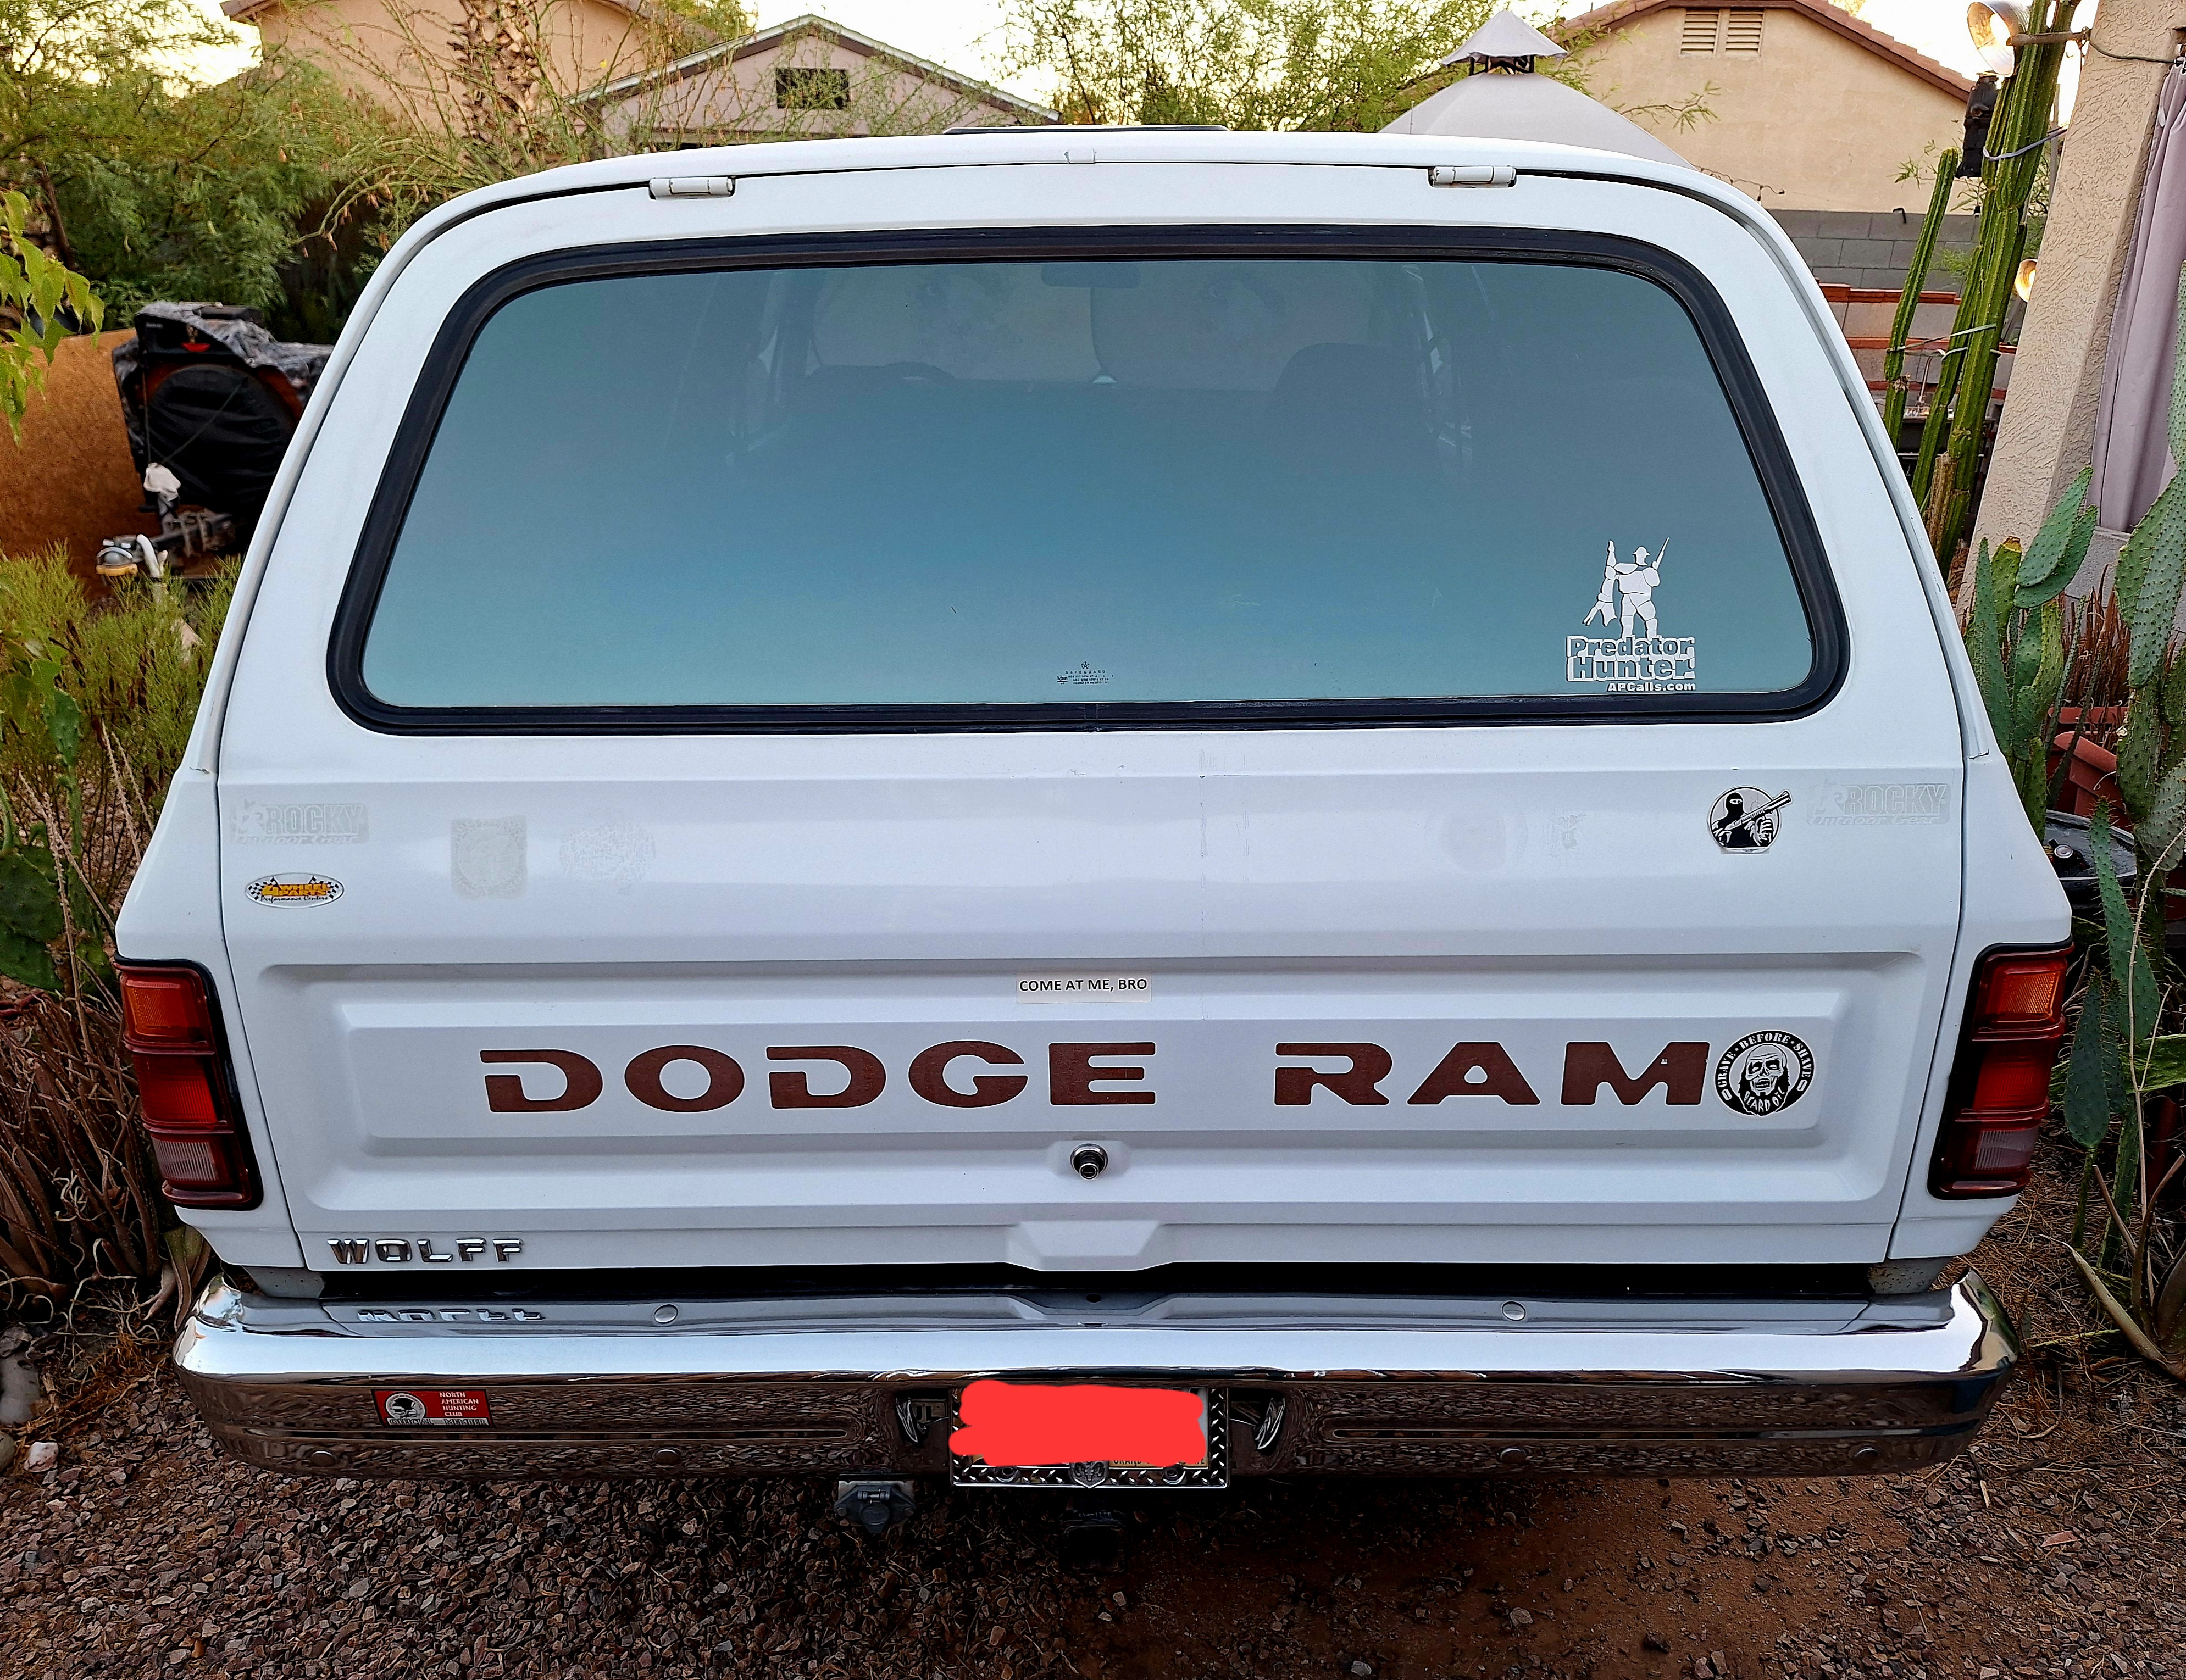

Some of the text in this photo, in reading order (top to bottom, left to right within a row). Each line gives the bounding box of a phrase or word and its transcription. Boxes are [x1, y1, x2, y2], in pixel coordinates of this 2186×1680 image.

[1569, 636, 1695, 657] Predator
[1571, 657, 1695, 680] Hunter
[1607, 682, 1696, 692] APCalls.com
[1843, 785, 1946, 816] ROCKY
[264, 804, 364, 835] ROCKY
[262, 884, 279, 897] 4
[1019, 978, 1147, 992] COME AT ME, BRO
[1717, 1033, 1812, 1088] GRAVE BEFORE SHAVE
[479, 1039, 1711, 1113] DODGE RAM
[1743, 1091, 1771, 1113] BEARD
[326, 1238, 524, 1264] WOLFF
